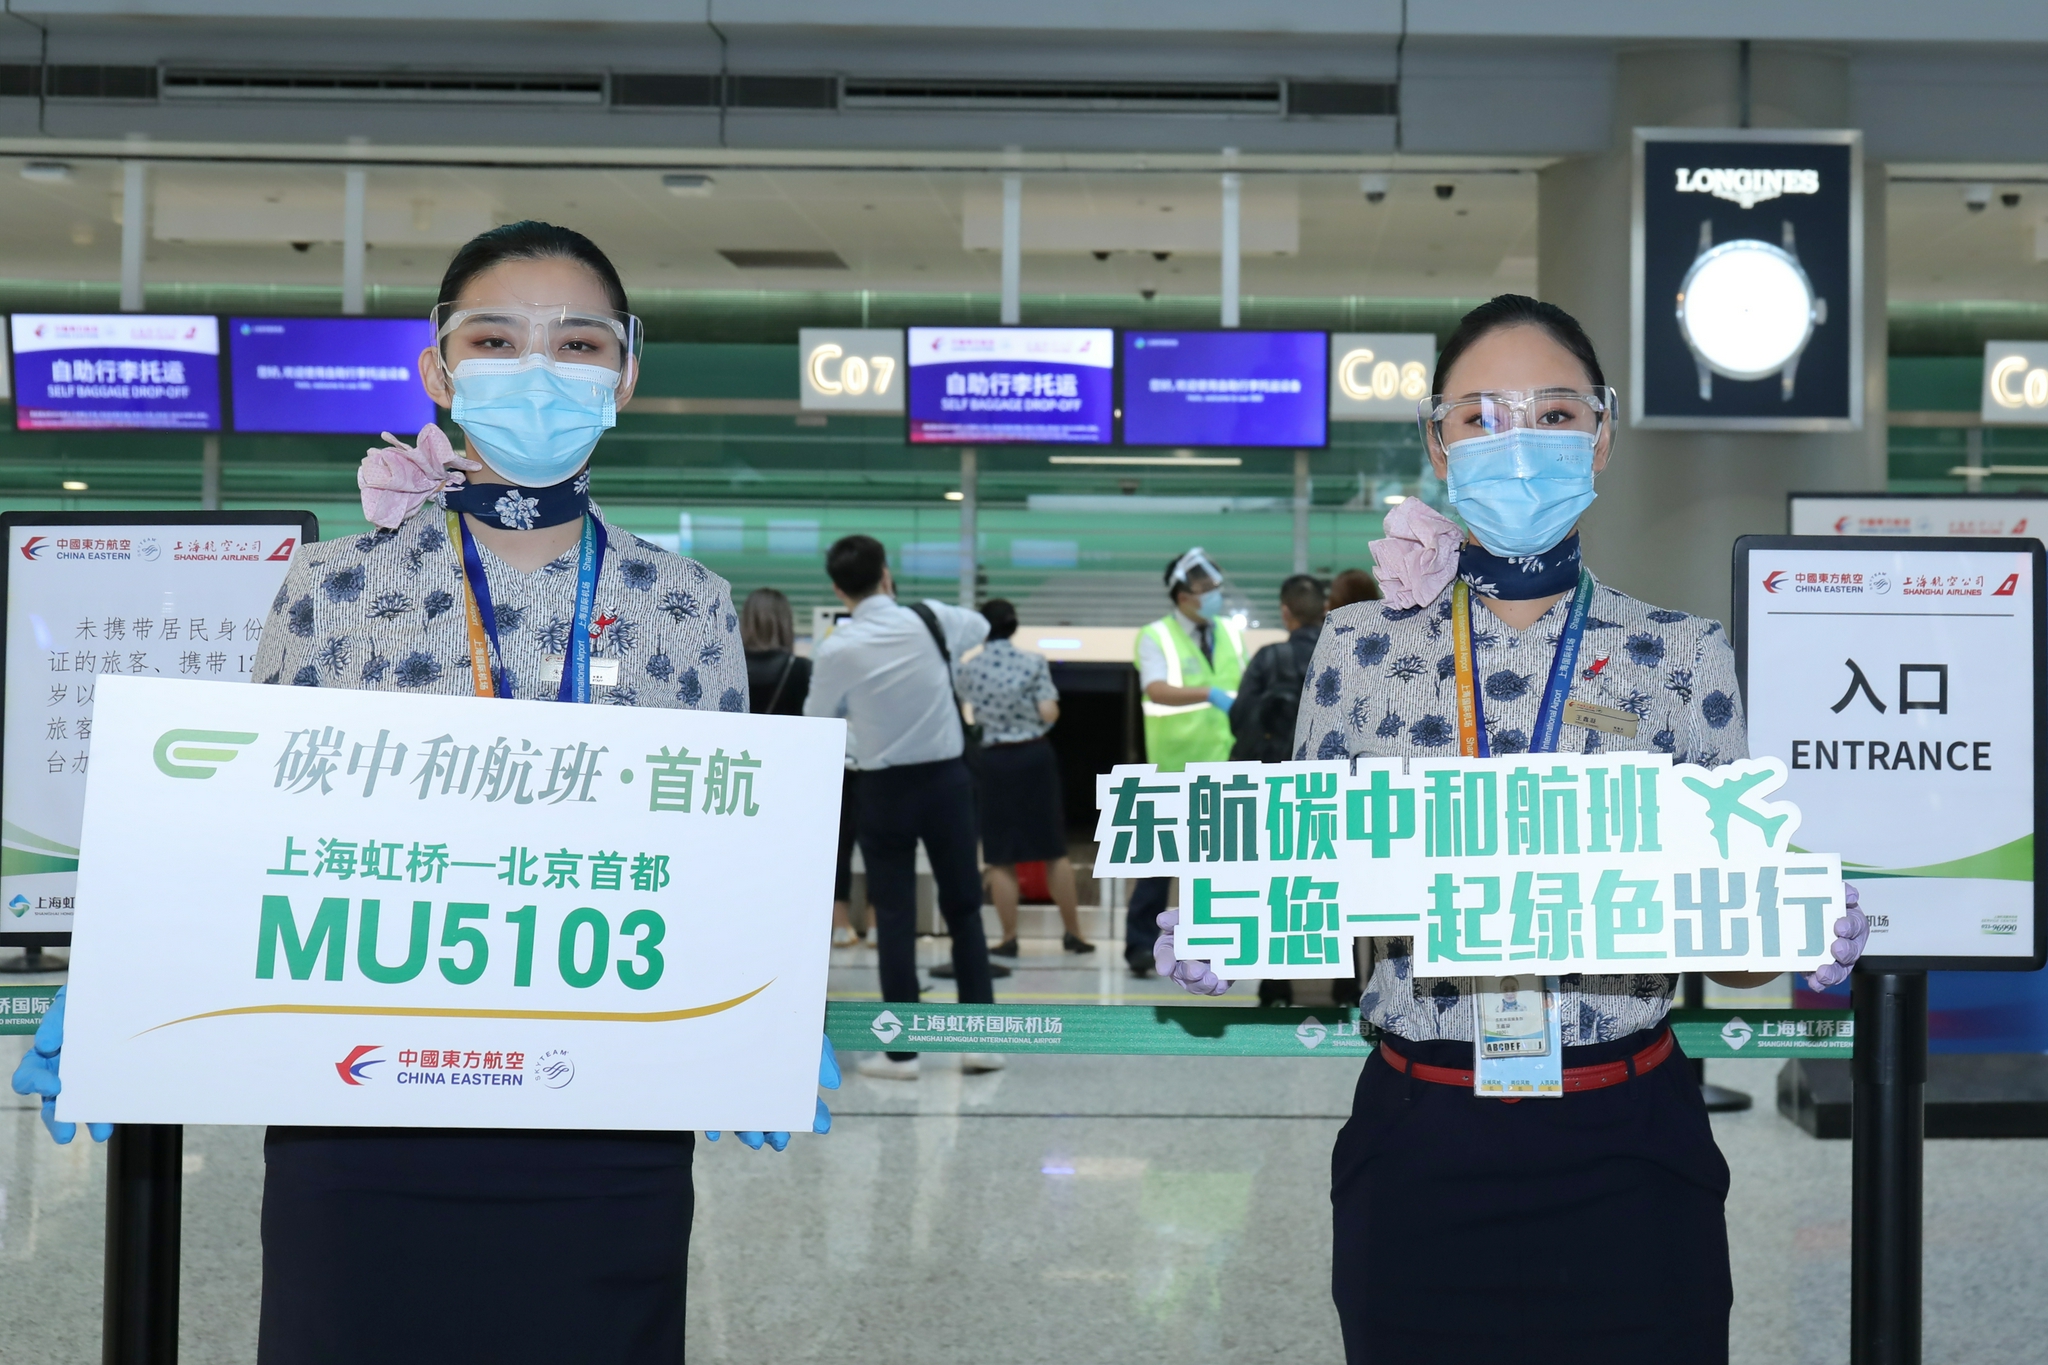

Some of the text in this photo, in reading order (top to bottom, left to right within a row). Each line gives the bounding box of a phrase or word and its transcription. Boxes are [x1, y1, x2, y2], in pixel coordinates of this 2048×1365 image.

[1676, 168, 1819, 194] LONGINES
[52, 359, 186, 384] 自助行李托运
[808, 344, 895, 395] C07
[1339, 349, 1427, 400] C08
[946, 372, 1078, 397] 自助行李托运
[57, 539, 131, 550] 中國東方航空
[57, 552, 131, 560] CHINA EASTERN
[173, 540, 261, 553] 上海航空公司
[582, 540, 595, 571] Shanghai
[1795, 573, 1863, 584] 中國東方航空
[1795, 585, 1863, 594] CHINA EASTERN
[1903, 574, 1984, 588] 上海航空公司
[1946, 588, 1982, 596] AIRLINES
[578, 581, 591, 629] 上海国际机场
[1570, 602, 1584, 630] Shanghai
[75, 616, 263, 642] 未携带居民身份
[577, 640, 587, 662] Airport
[1830, 657, 1948, 715] 入口
[1541, 690, 1563, 750] International Airport
[1791, 740, 1992, 771] ENTRANCE
[1109, 764, 1662, 865] 东航碳中和航班
[35, 896, 75, 909] 上海虹
[1187, 867, 1833, 967] 与您一起绿色出行
[255, 895, 668, 990] MU5103
[908, 1014, 1063, 1034] 上海虹桥国际机场
[1758, 1020, 1854, 1037] 上海虹桥国
[944, 1035, 979, 1043] HONGQIAO
[980, 1036, 1032, 1044] INTERNATIONAL
[398, 1049, 525, 1070] 中國東方航空
[534, 1049, 570, 1081] SKYTEAM
[397, 1072, 523, 1086] CHINA EASTERN
